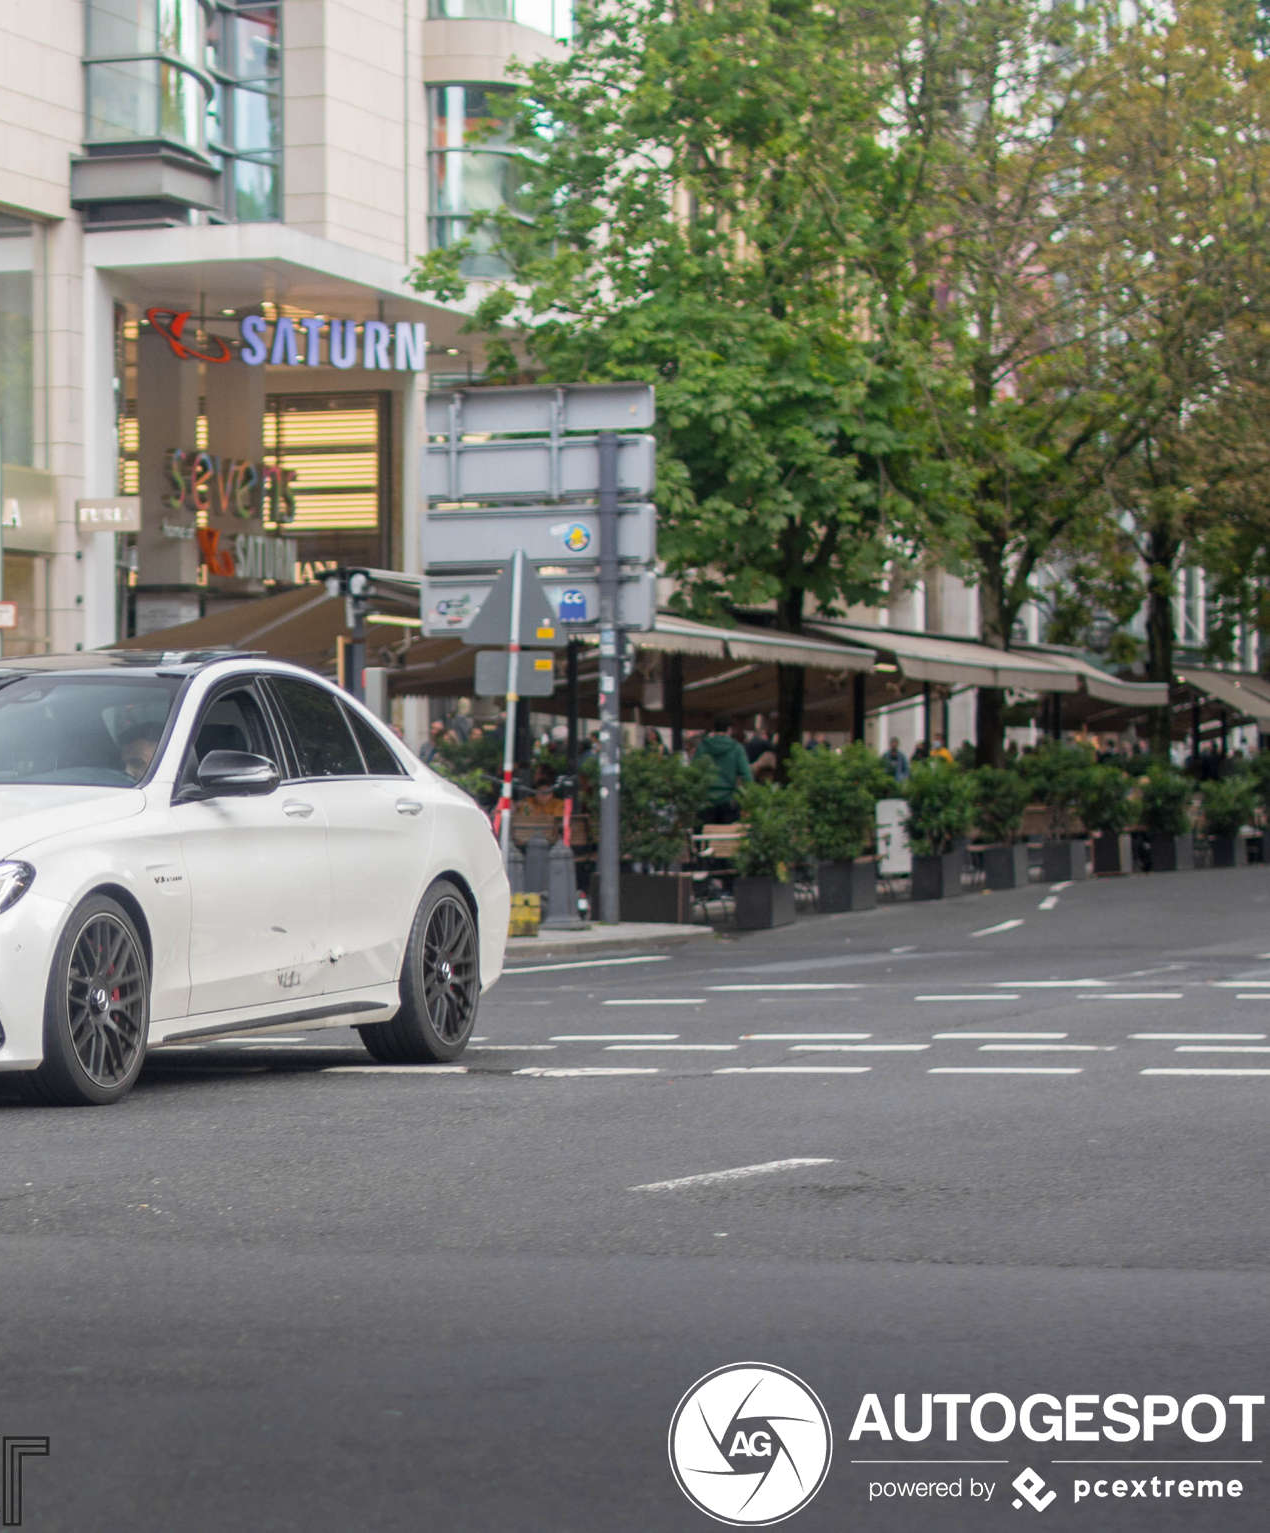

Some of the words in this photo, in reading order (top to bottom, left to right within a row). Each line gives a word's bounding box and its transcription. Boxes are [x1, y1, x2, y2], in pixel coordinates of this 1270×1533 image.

[241, 315, 427, 372] SATURN
[167, 450, 297, 524] sevens
[235, 533, 298, 583] SATURN
